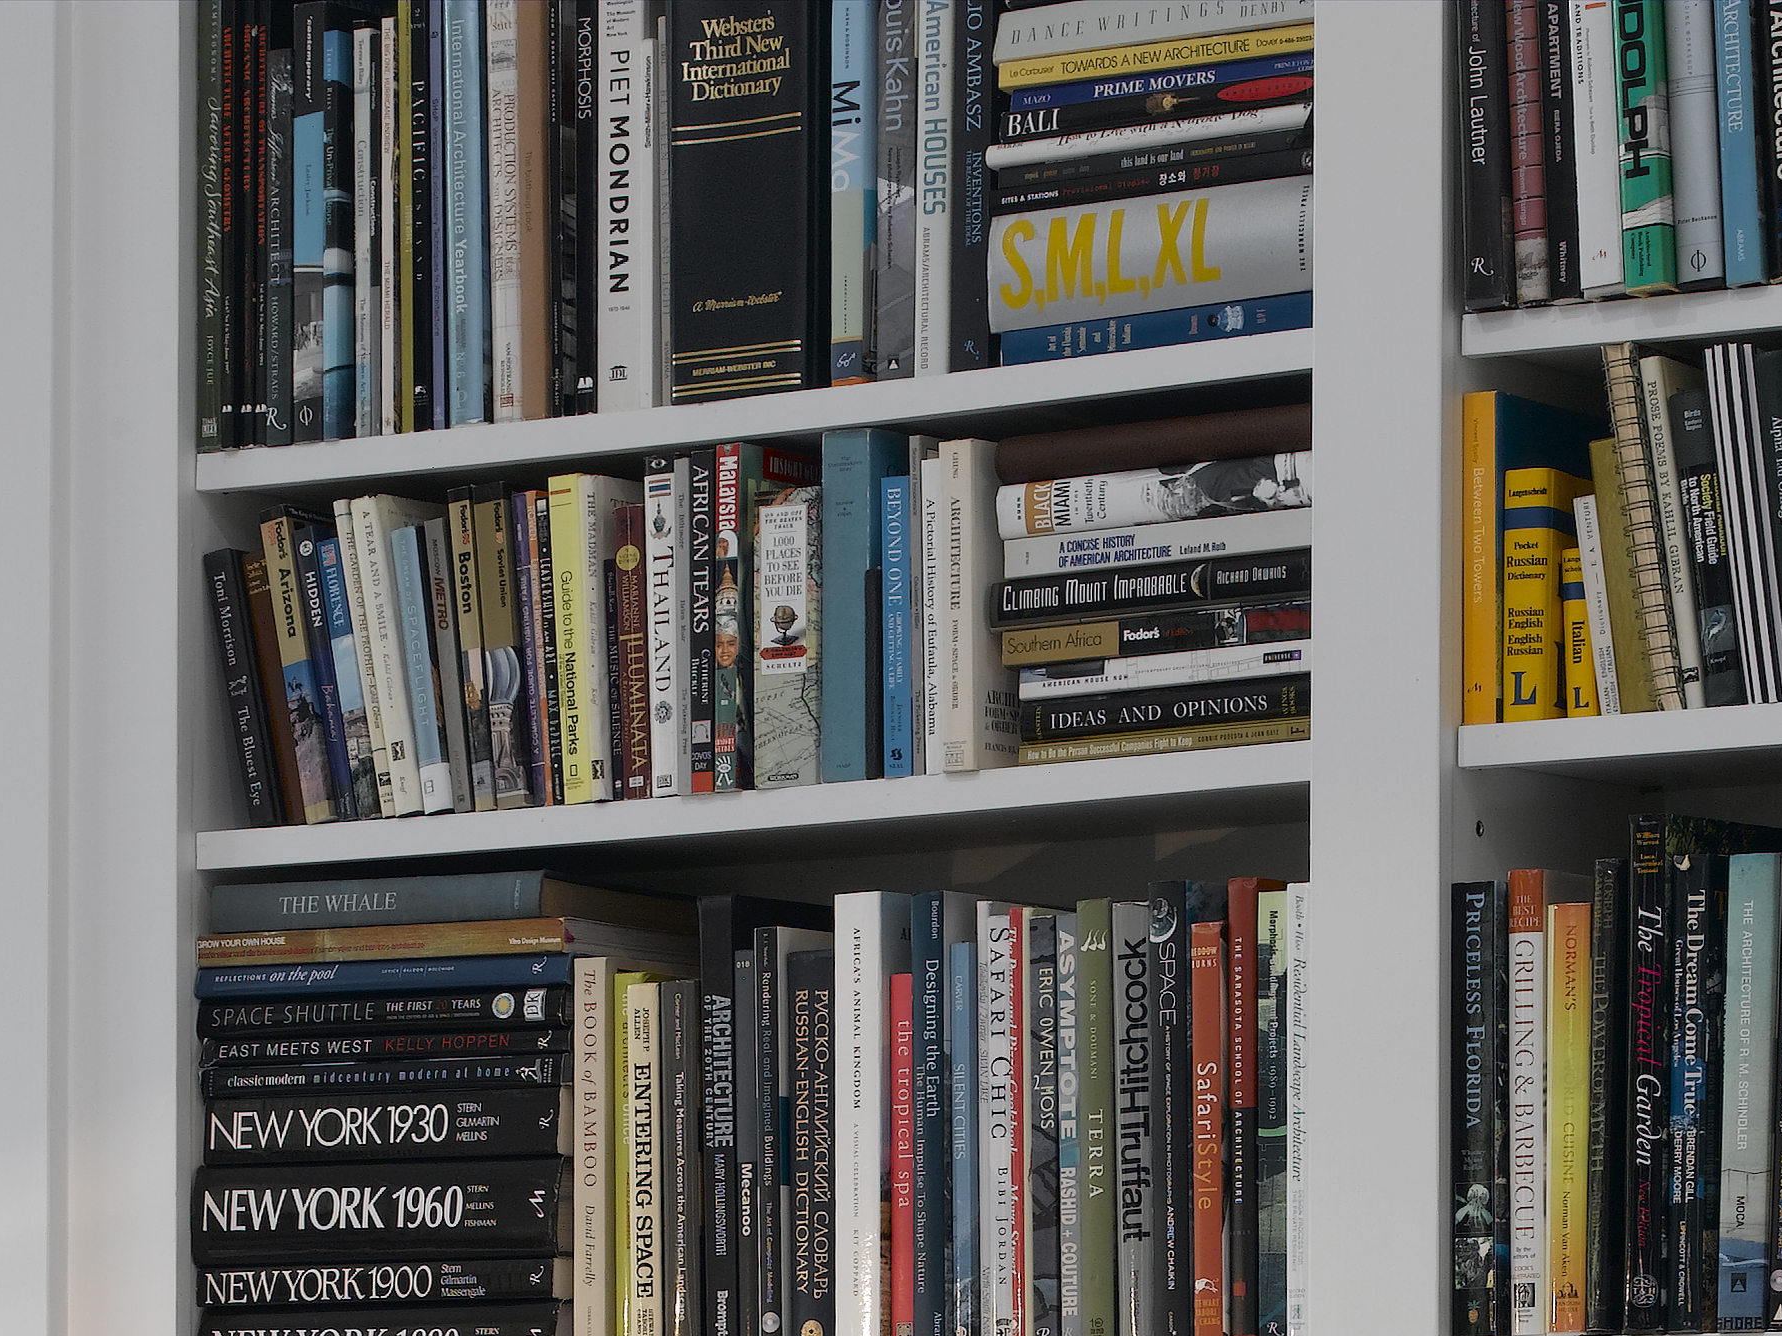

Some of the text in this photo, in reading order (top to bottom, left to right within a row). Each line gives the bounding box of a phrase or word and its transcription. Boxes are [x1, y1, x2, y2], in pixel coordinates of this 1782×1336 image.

[700, 11, 775, 39] Webster's
[681, 48, 790, 82] International
[689, 32, 784, 62] Third New
[1060, 38, 1250, 75] TOWARDS A NEW ARCHITECTURE
[577, 16, 593, 120] MORPHOSIS
[1093, 70, 1217, 98] PRIME MOVERS
[691, 74, 783, 103] Dictionary
[1006, 107, 1061, 136] BALI
[607, 49, 631, 295] PIET MONDRIAN
[691, 465, 711, 633] AFRICAN TEARS
[1506, 555, 1548, 570] Russian
[1514, 540, 1539, 551] Pocket
[1507, 570, 1547, 583] Dictionary
[652, 545, 672, 693] THAILAND
[1571, 619, 1585, 665] Italian
[1049, 694, 1269, 730] IDEAS AND OPINIONS
[210, 1001, 375, 1028] SPACE SHUTTLE
[1464, 891, 1485, 1128] PRICELESS FLORIDA
[989, 927, 1009, 1140] SAFARI CHIC
[1057, 932, 1077, 1140] ASYMPTOTE
[456, 1102, 482, 1113] STERN
[1512, 939, 1537, 1241] GRILLING & BARBECUE
[209, 1103, 450, 1150] NEW YORK 1930
[456, 1115, 501, 1127] GILMARTIN
[456, 1130, 488, 1142] MELLINS
[201, 1185, 464, 1231] NEW YORK 1960
[740, 1163, 752, 1237] Mecanoo
[813, 1207, 830, 1300] СЛОВАРЬ
[203, 1265, 433, 1304] NEW YORK 1900
